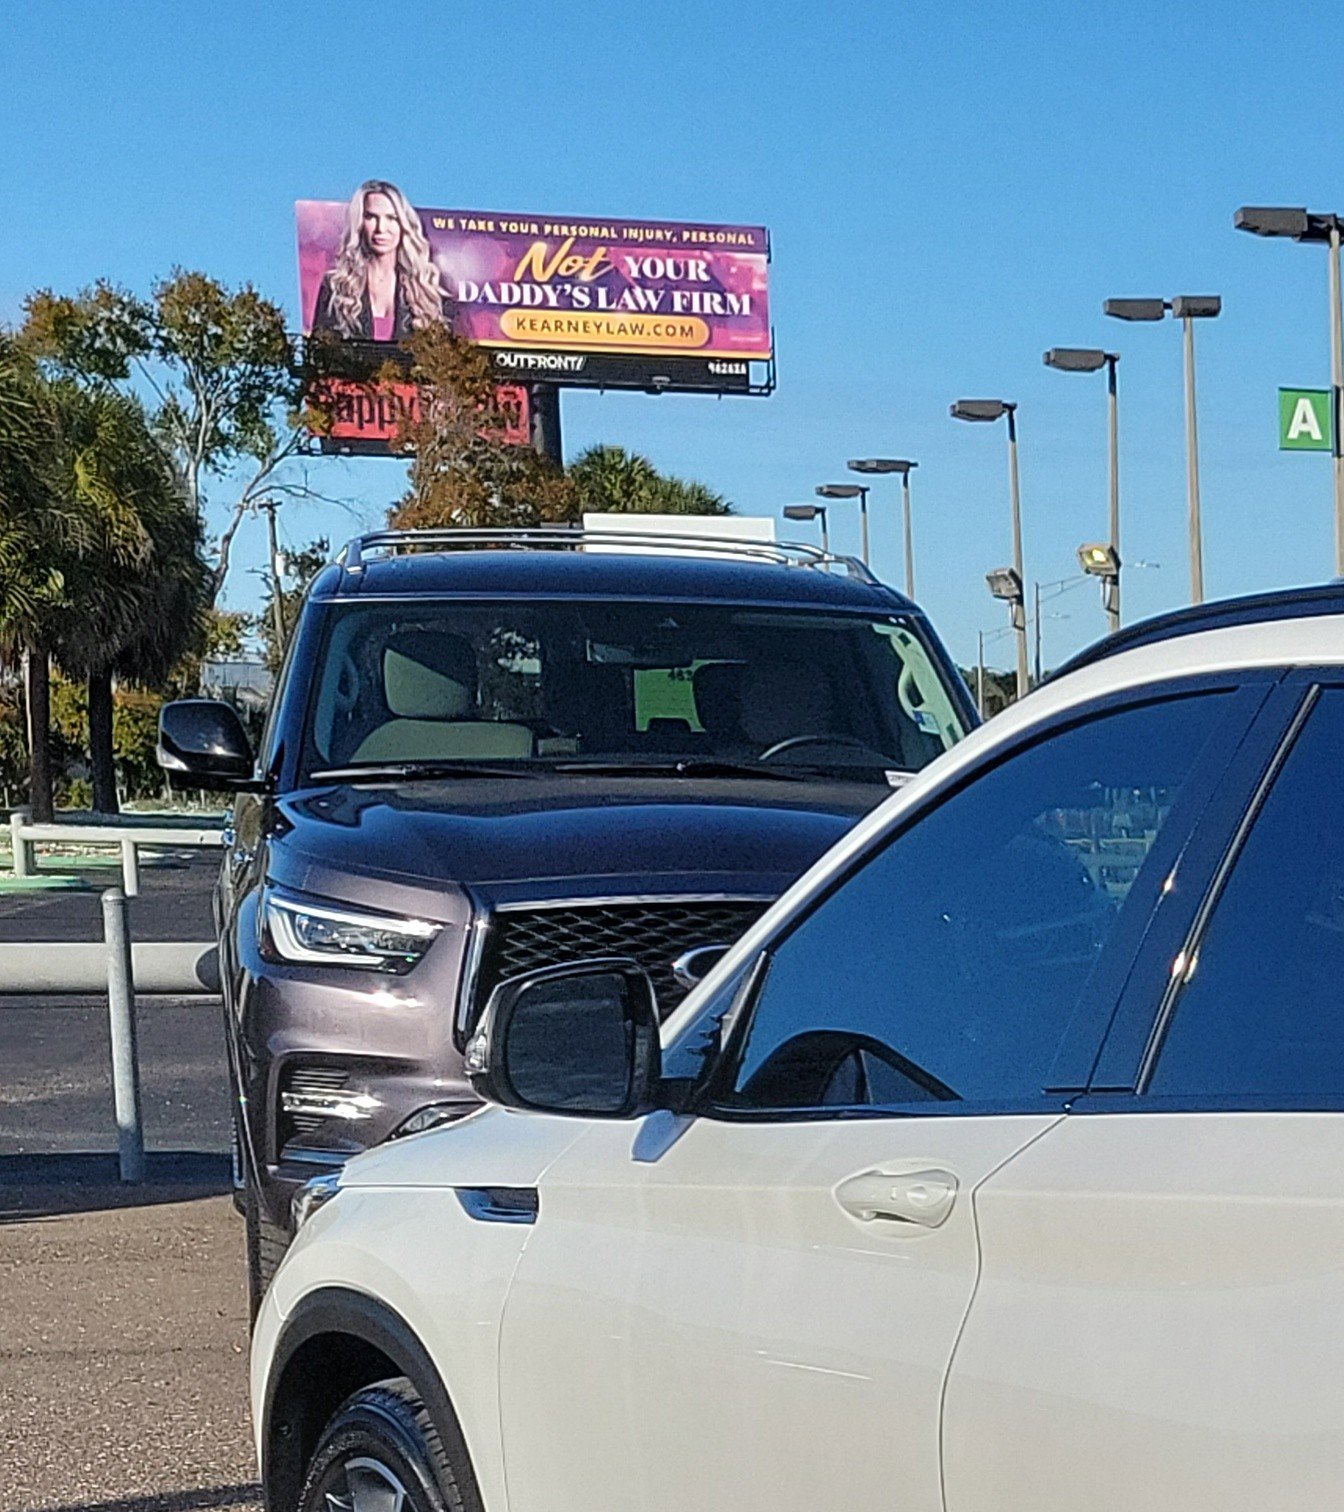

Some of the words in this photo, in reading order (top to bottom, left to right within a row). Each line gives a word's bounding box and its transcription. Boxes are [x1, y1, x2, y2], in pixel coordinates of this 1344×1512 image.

[433, 217, 455, 230] WE
[459, 218, 495, 232] TAKE
[500, 221, 539, 235] YOUR
[544, 224, 618, 239] PERSONAL
[623, 227, 677, 244] INJURY,
[682, 230, 755, 246] PERSONAL
[513, 236, 615, 283] Not
[624, 255, 711, 282] YOUR
[457, 279, 592, 309] DADDY'S
[597, 286, 665, 312] LAW
[672, 290, 751, 316] FIRM
[516, 317, 694, 338] KEARNEYLAW.COM
[1287, 397, 1323, 440] A
